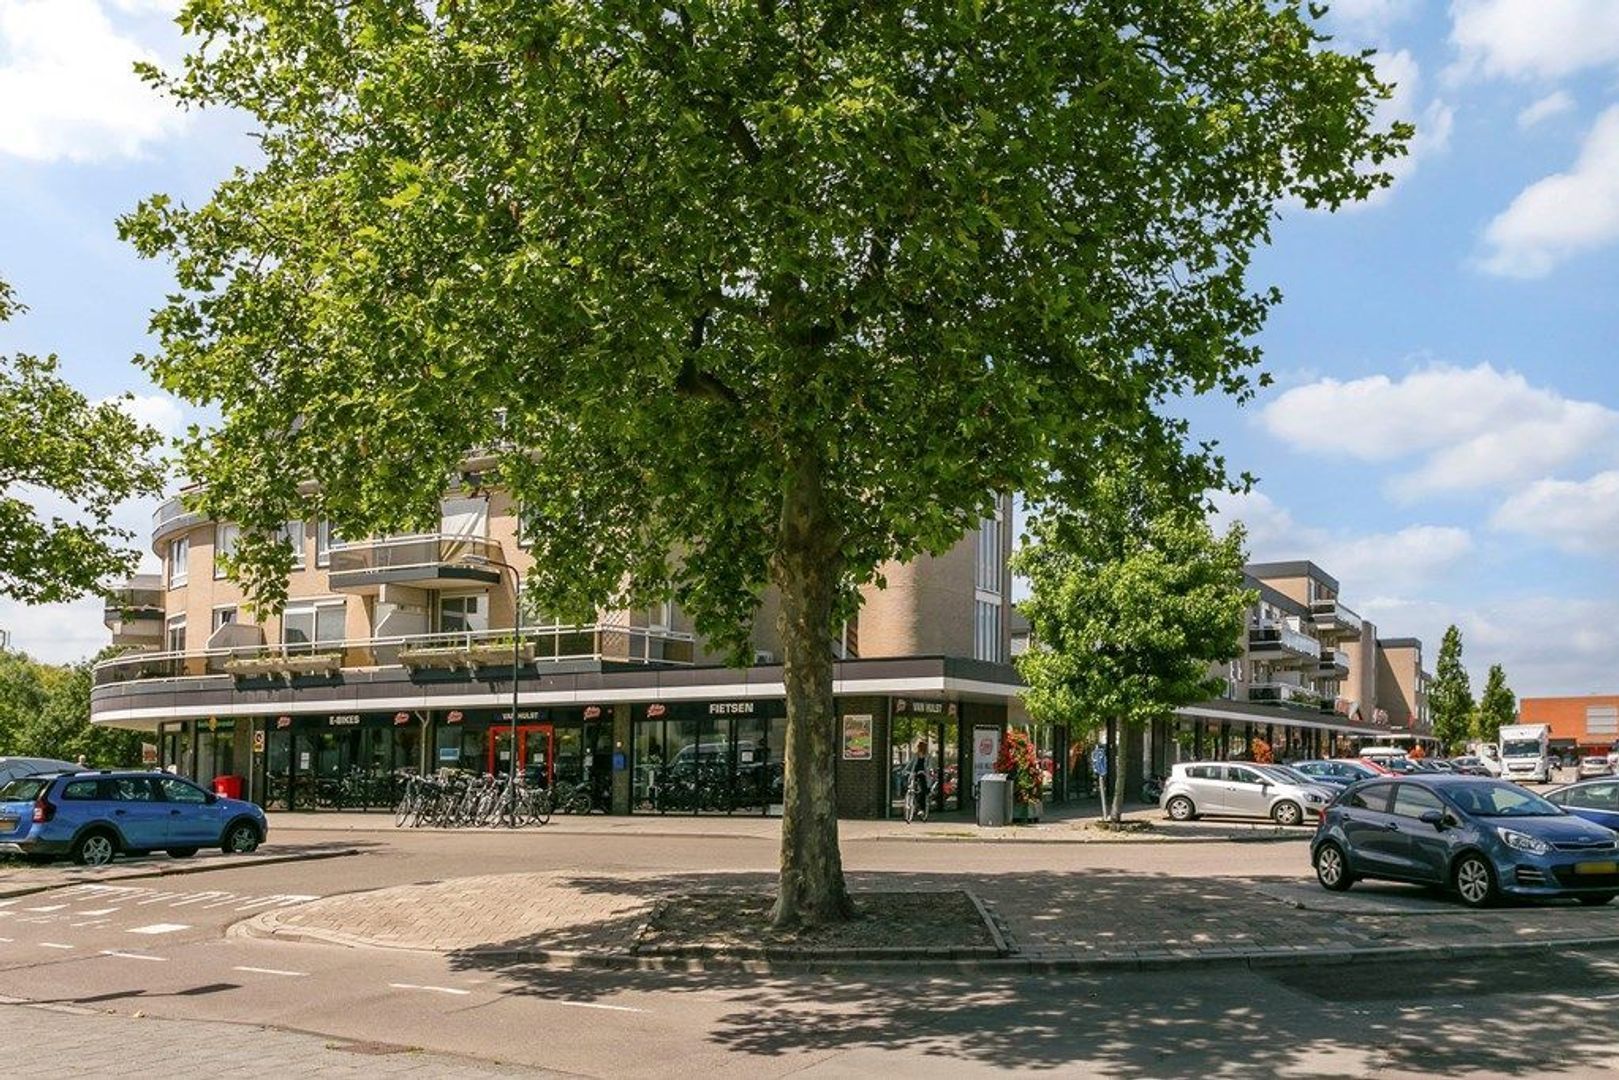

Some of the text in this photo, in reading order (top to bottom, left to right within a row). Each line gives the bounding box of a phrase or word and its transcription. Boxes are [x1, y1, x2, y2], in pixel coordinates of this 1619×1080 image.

[709, 703, 754, 714] FIETSEN
[328, 714, 360, 726] E-BIKES
[517, 711, 539, 720] HULST
